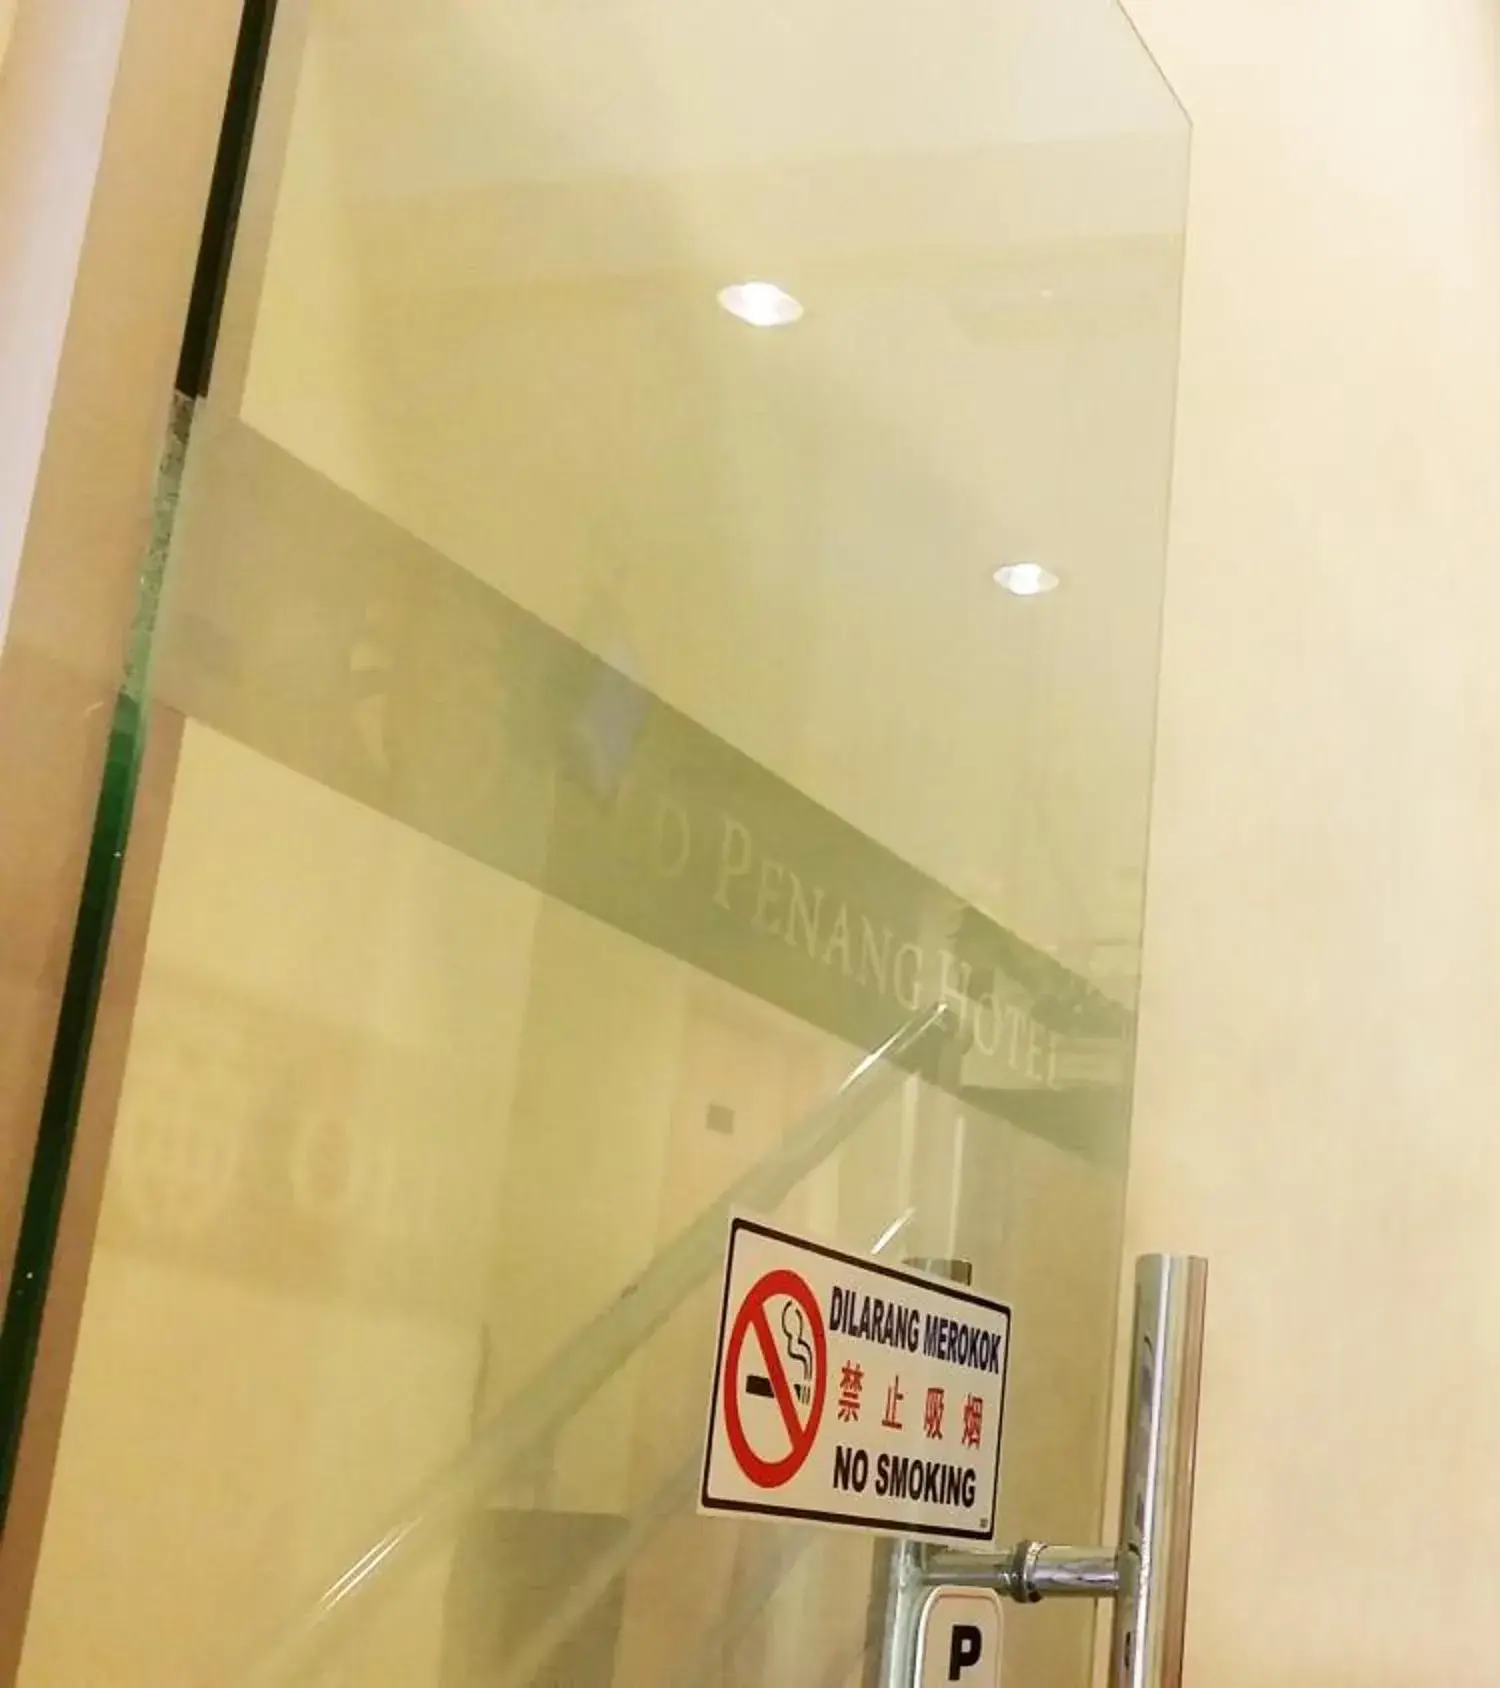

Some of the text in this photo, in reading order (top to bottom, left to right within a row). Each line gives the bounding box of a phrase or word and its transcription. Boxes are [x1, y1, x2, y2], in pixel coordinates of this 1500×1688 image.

[712, 812, 924, 1012] PENANG
[829, 1285, 1002, 1376] DILARANG MEROKOK
[837, 1359, 984, 1450] 禁止吸烟
[832, 1445, 977, 1508] NO SMOKING
[947, 1624, 983, 1681] P
